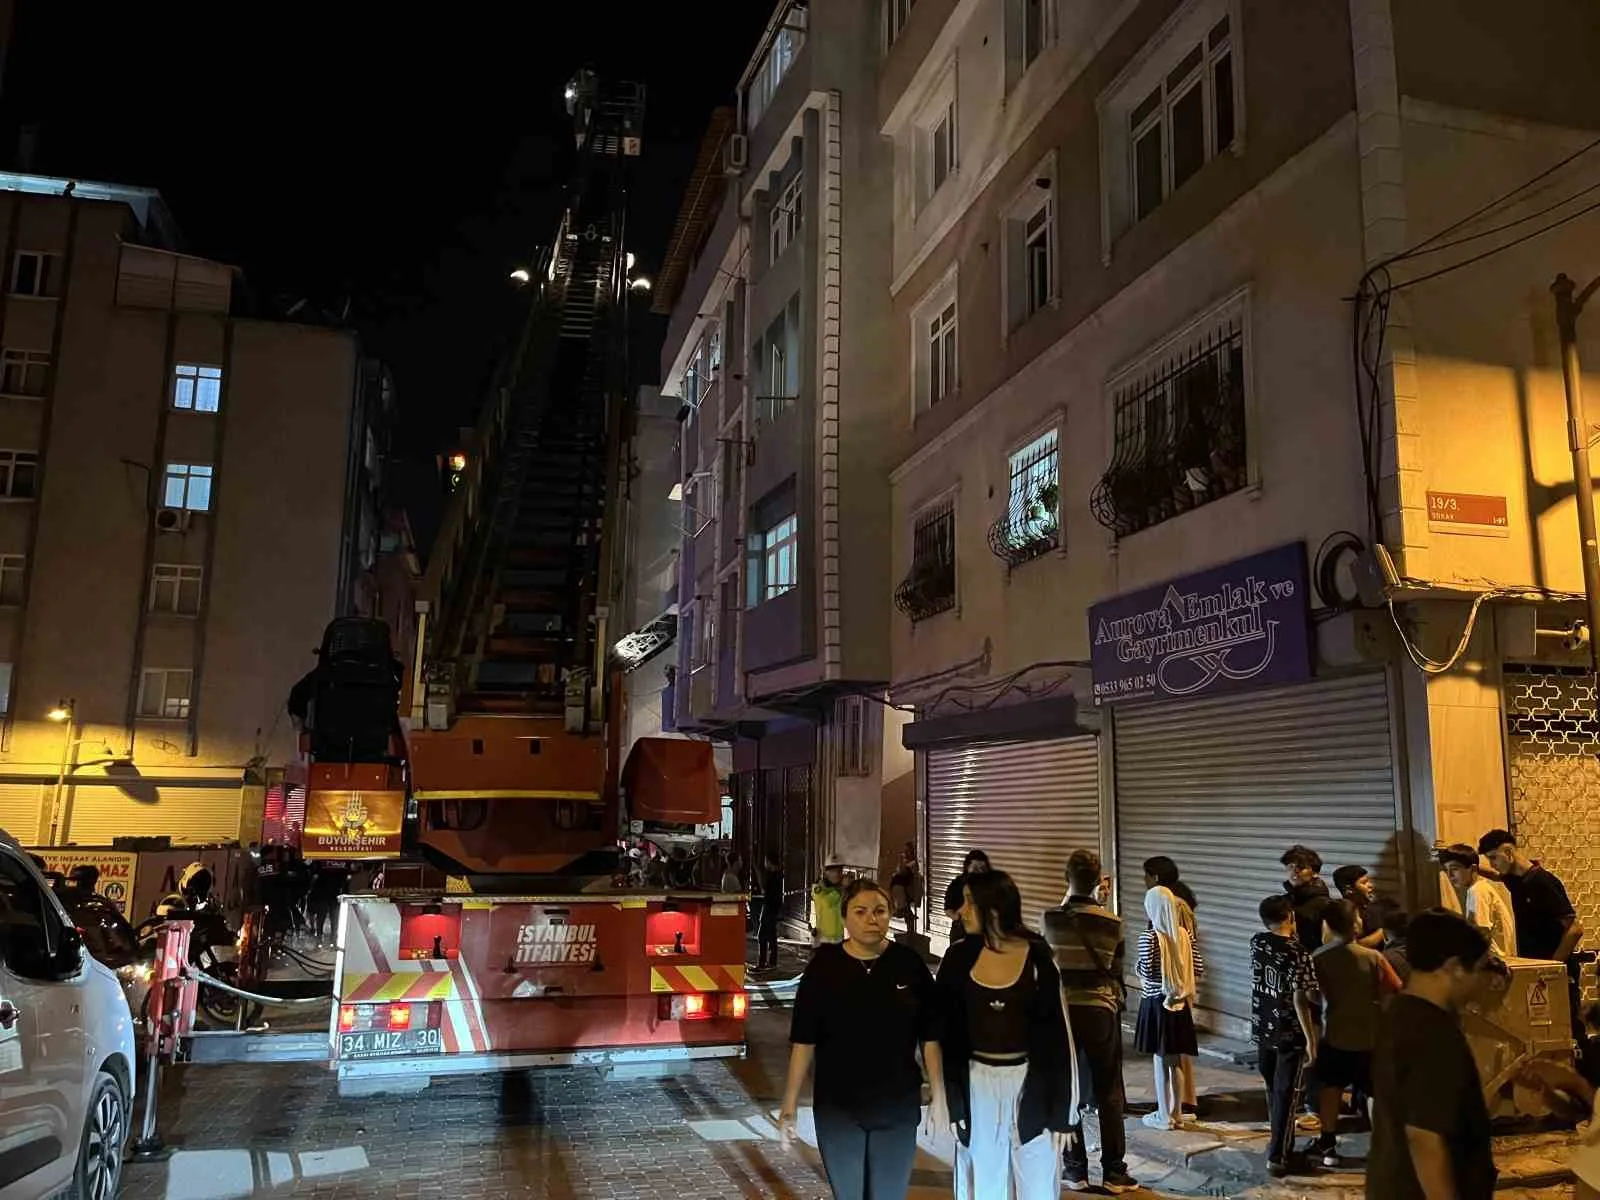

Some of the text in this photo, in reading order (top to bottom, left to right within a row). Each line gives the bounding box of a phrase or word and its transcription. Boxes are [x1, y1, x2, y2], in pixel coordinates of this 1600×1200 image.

[1095, 576, 1295, 645] Aurova Emlak ve
[1116, 604, 1264, 663] Gayrimenkul
[343, 1035, 363, 1052] 34
[374, 1032, 401, 1050] MIZ
[418, 1029, 437, 1046] 30
